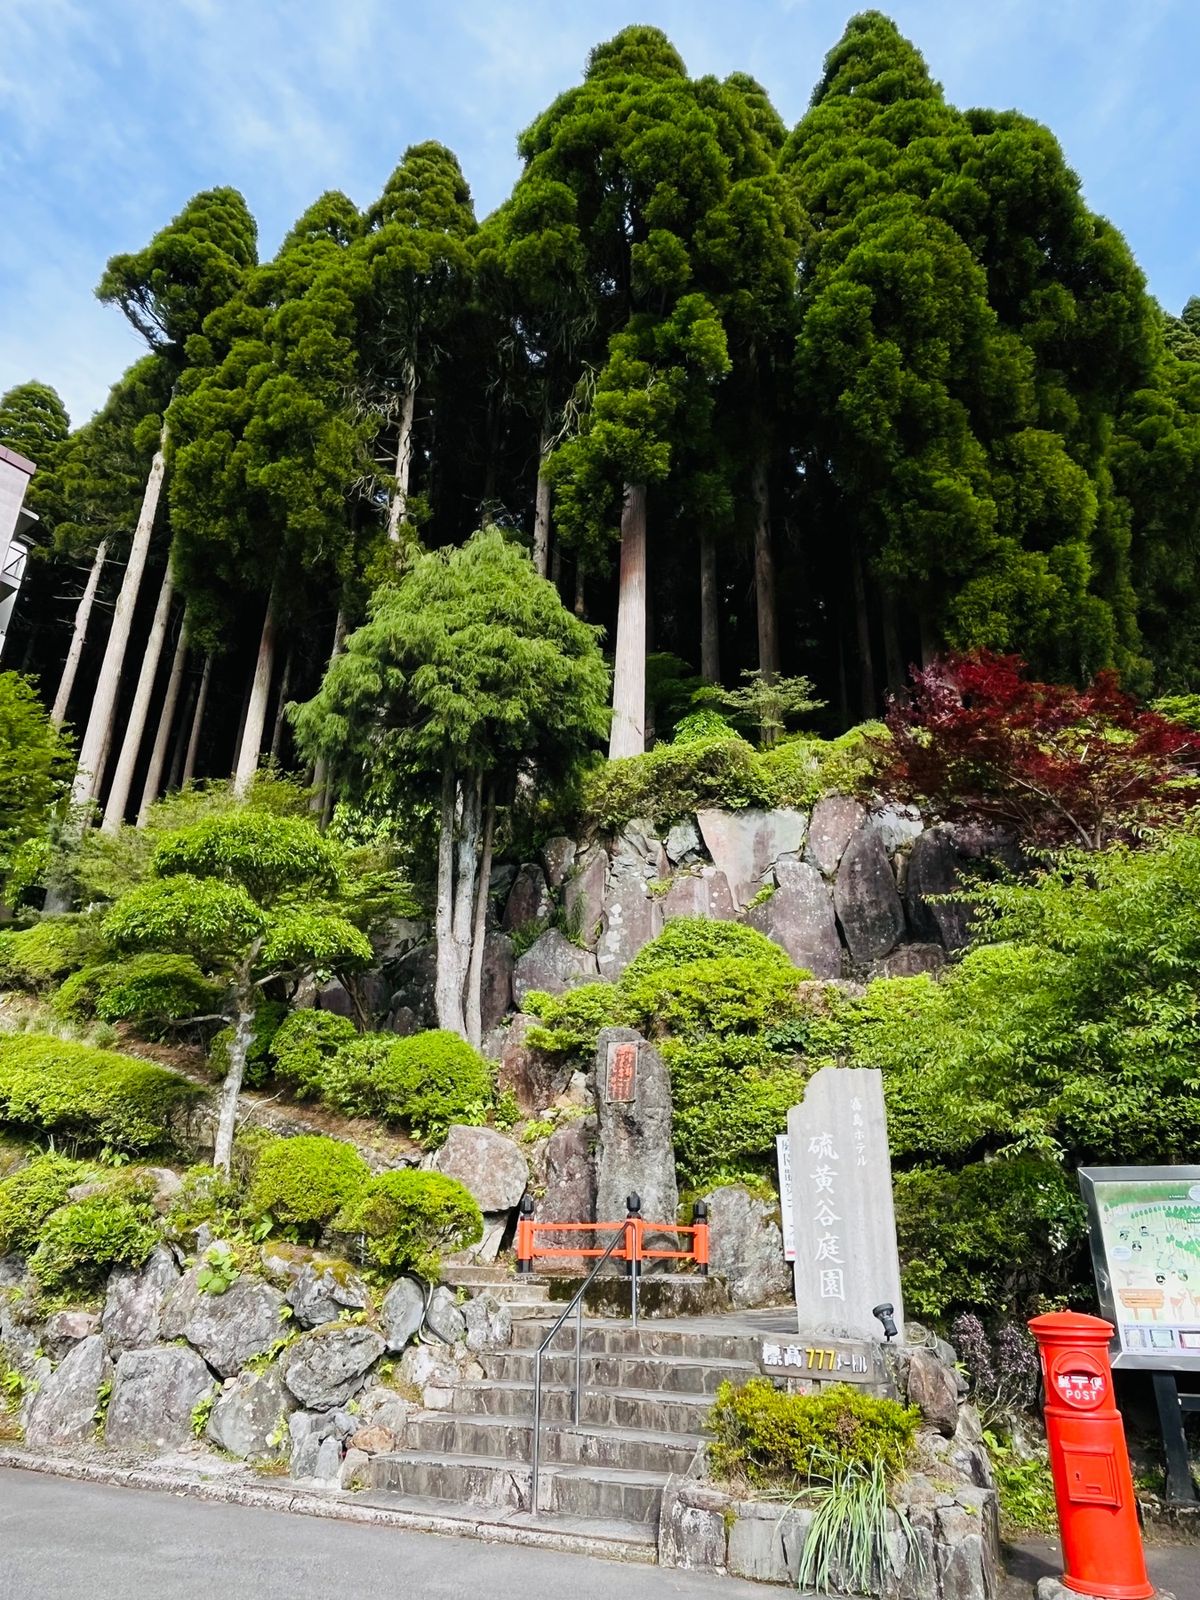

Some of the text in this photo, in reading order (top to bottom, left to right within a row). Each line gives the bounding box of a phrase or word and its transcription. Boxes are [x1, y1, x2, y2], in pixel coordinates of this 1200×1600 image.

[807, 1131, 846, 1301] 硫黄谷庭園
[1066, 1390, 1097, 1400] POST
